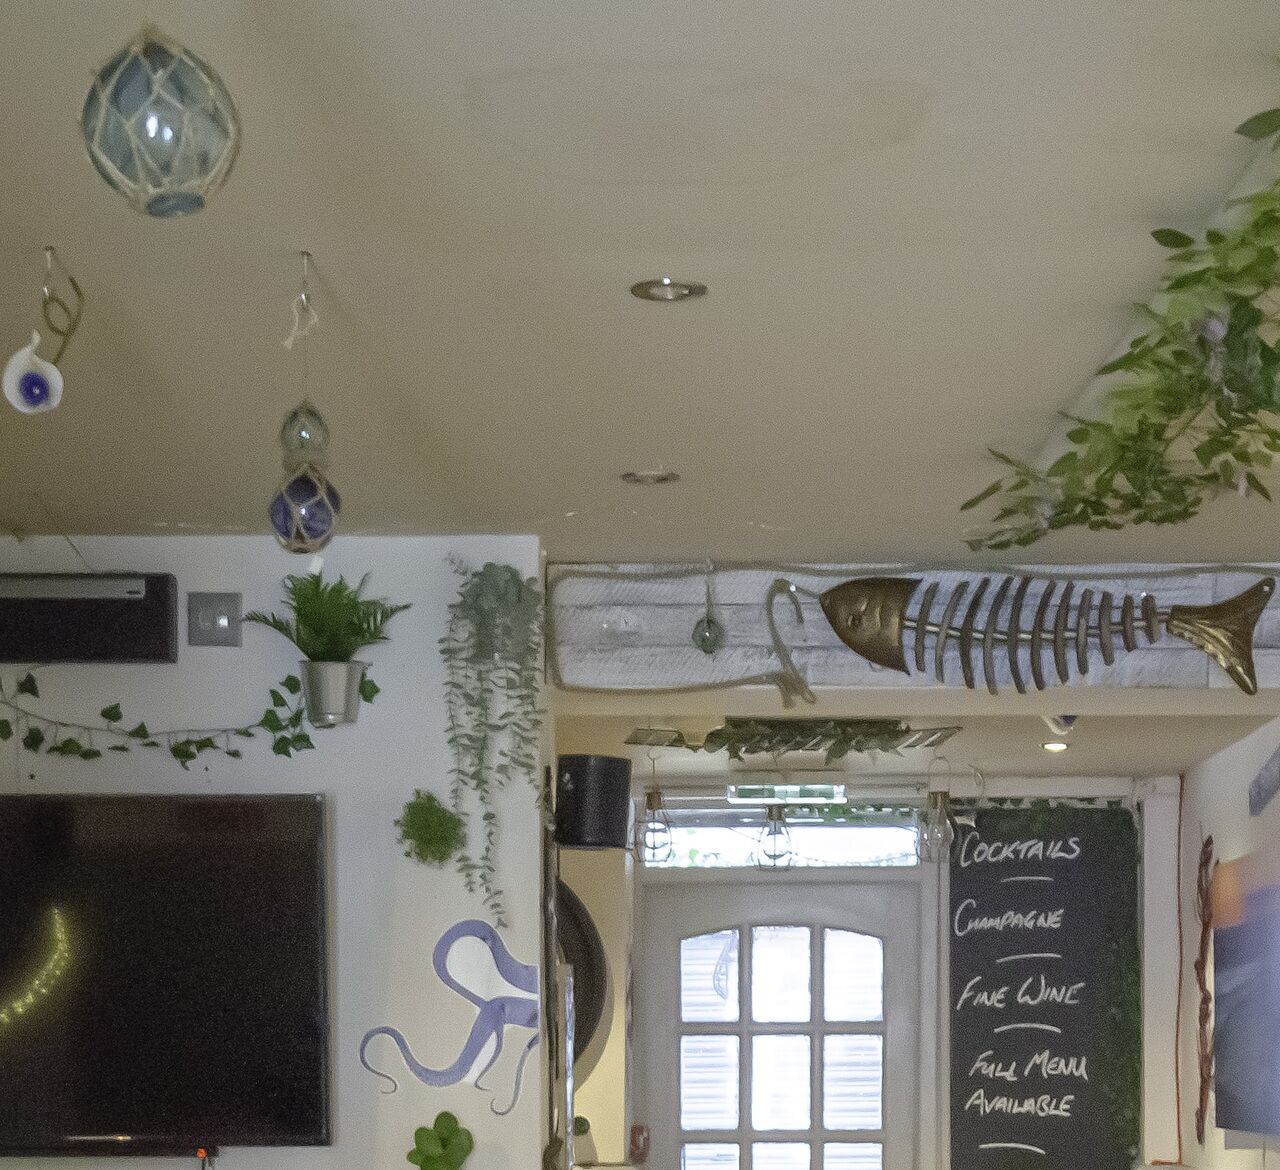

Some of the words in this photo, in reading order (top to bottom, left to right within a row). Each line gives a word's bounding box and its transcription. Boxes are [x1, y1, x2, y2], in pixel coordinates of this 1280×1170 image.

[960, 831, 1081, 868] COCKTAILS
[954, 899, 1065, 937] CHAMPAGNE
[956, 976, 1008, 1010] FINE
[1017, 974, 1085, 1007] WINE
[969, 1051, 1018, 1082] FULL
[1024, 1050, 1089, 1081] MENU
[964, 1088, 1075, 1117] AVAILABLE
